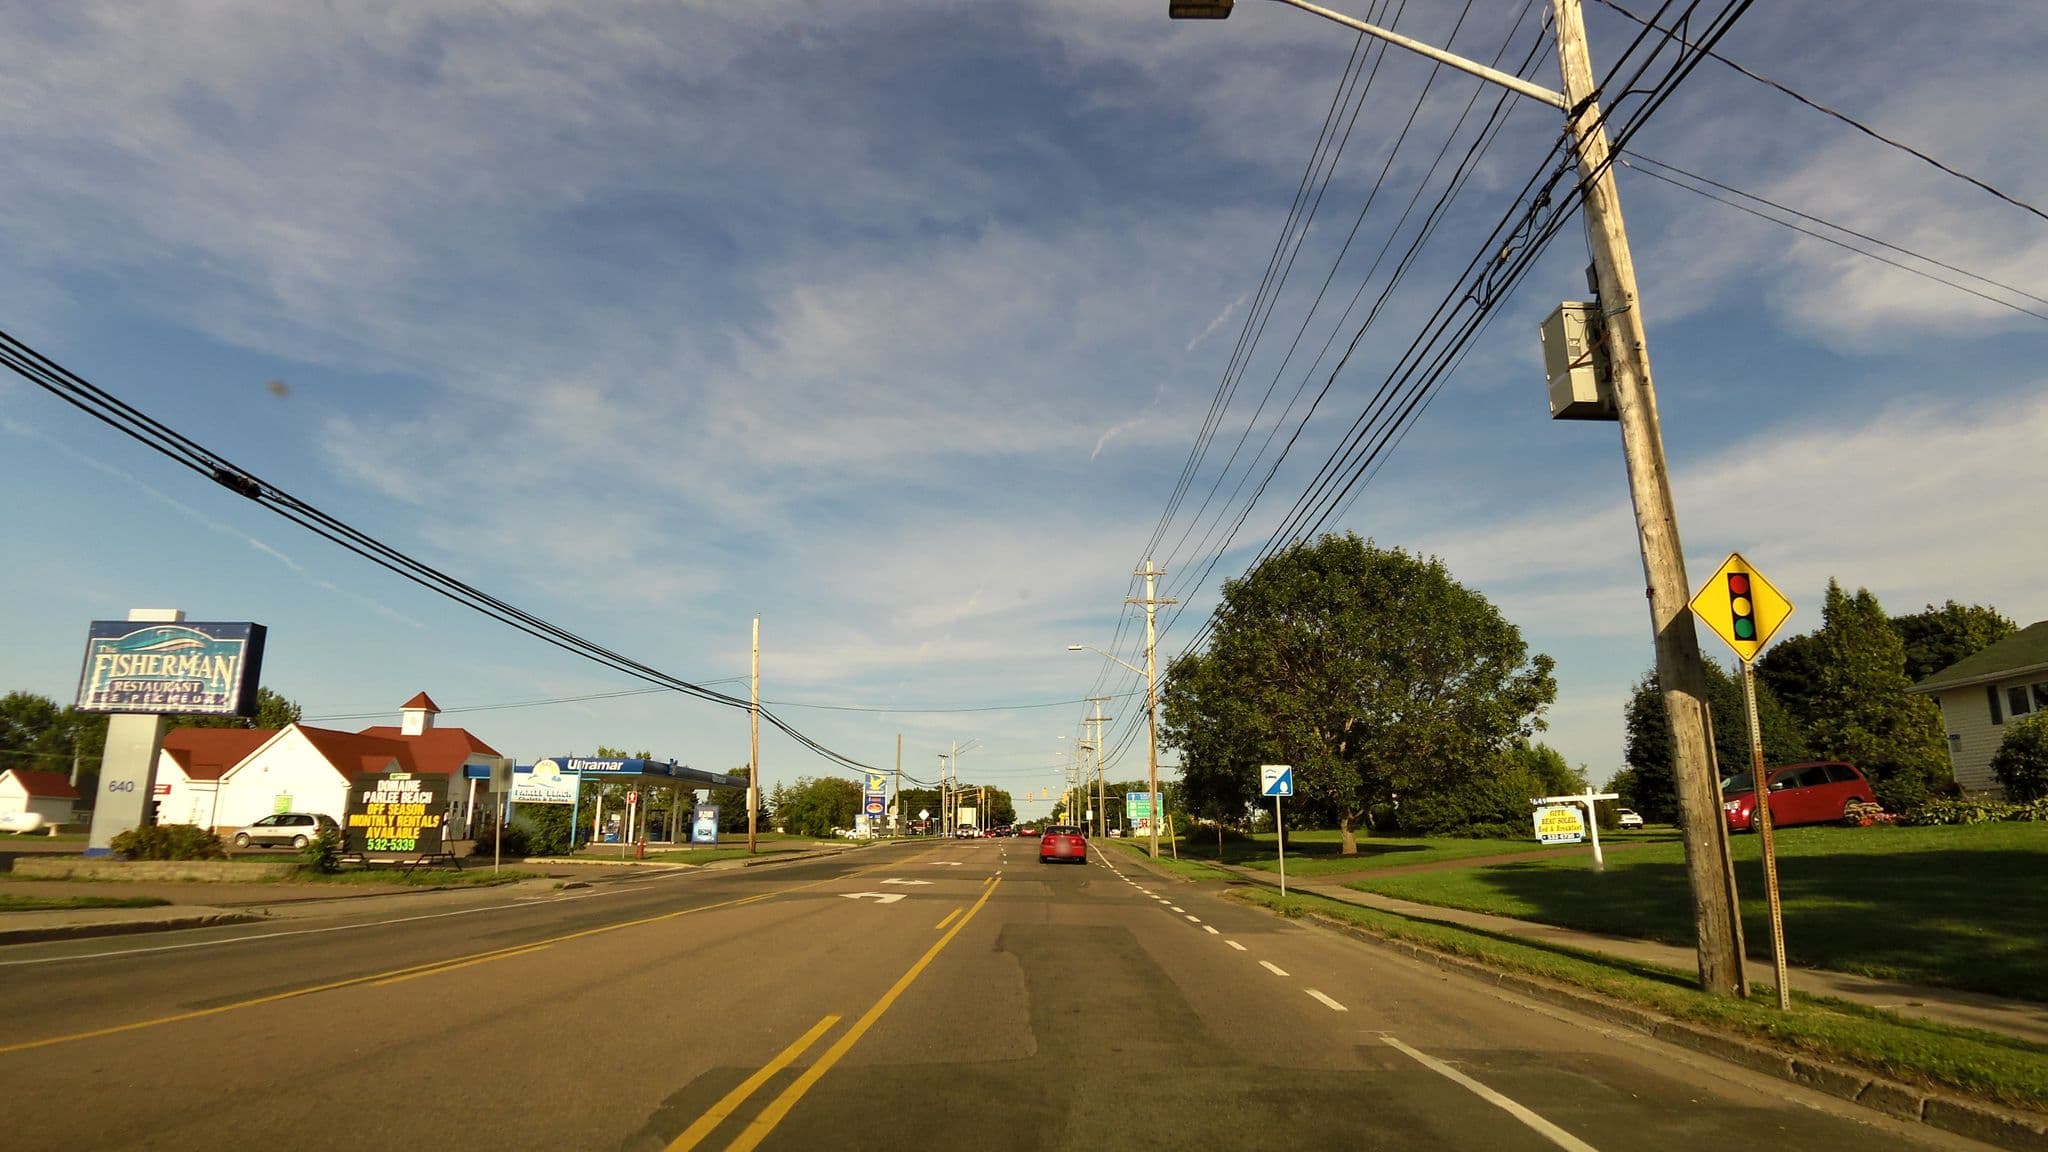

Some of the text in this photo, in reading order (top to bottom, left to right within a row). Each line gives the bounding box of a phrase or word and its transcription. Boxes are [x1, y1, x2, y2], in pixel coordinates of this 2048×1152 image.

[91, 653, 237, 698] FISHERMAN
[113, 681, 201, 693] RESTAURANT
[108, 780, 135, 793] 640
[377, 780, 422, 792] DOMAINE
[362, 791, 433, 804] PARLEE BEACH
[367, 803, 426, 816] OFF SEASON
[349, 814, 440, 828] MONTHLY RENTALS
[365, 827, 421, 839] AVAILABLE
[367, 838, 416, 851] 532-5339
